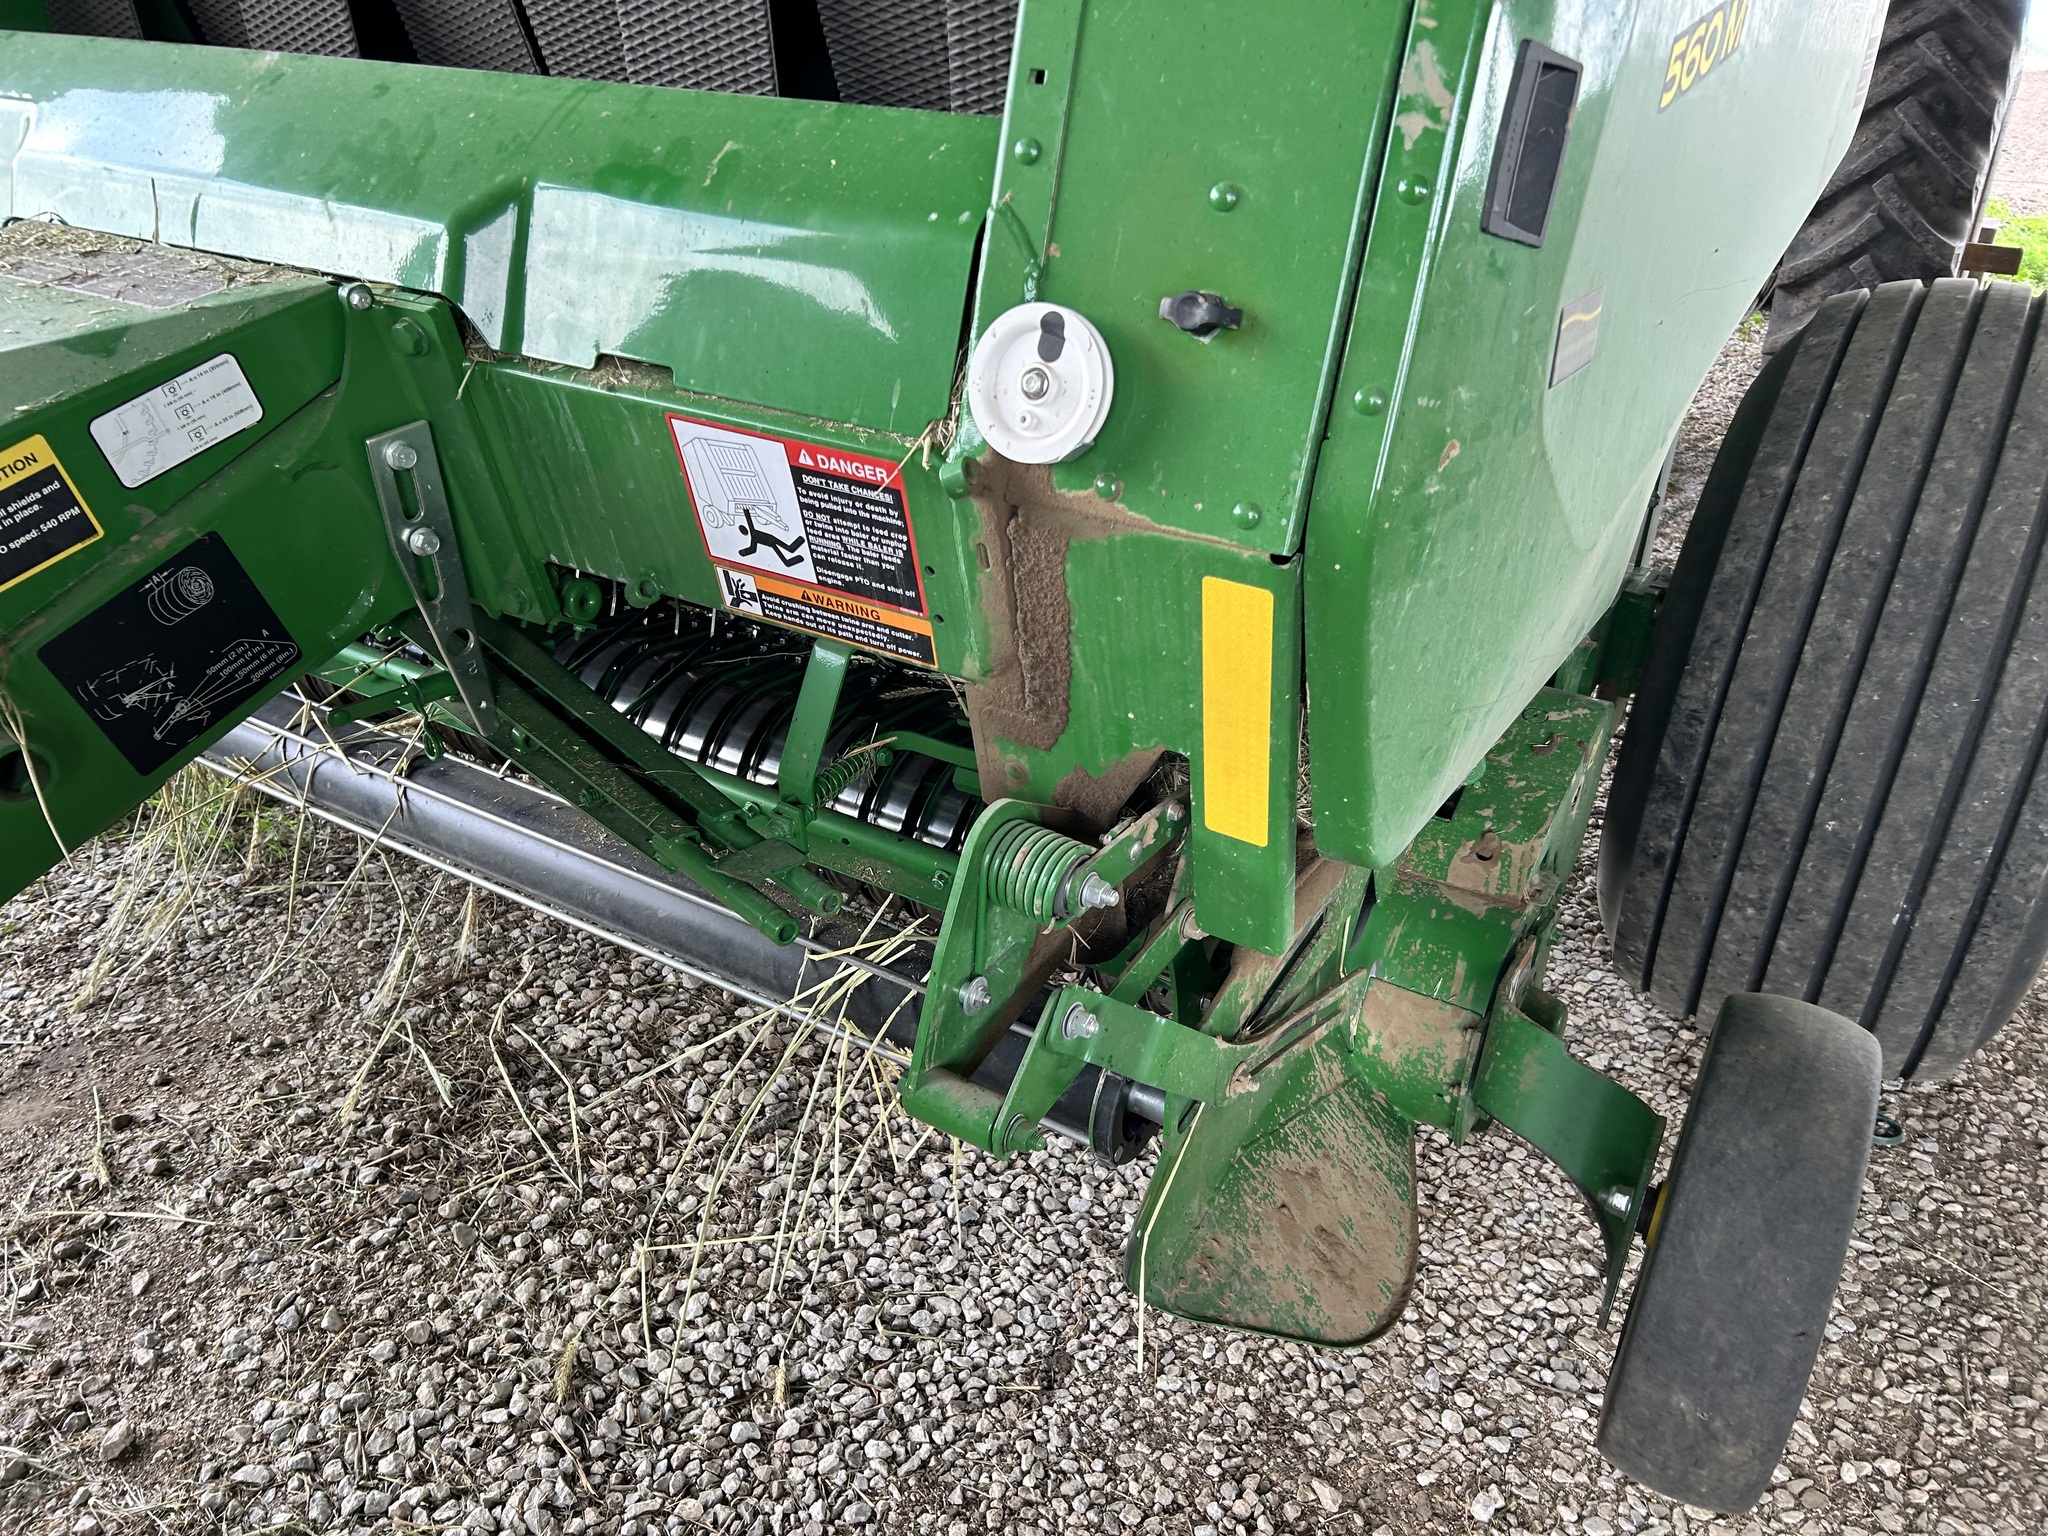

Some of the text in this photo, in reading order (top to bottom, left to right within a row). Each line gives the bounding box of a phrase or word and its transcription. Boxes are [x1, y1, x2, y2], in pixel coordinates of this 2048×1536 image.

[0, 452, 38, 480] TION
[816, 454, 888, 482] DANGER
[7, 491, 41, 512] shields
[42, 480, 60, 496] and
[798, 487, 806, 495] To
[808, 490, 829, 500] avoid
[830, 495, 853, 507] injury
[865, 503, 887, 514] death
[889, 509, 899, 518] by
[802, 474, 893, 503] DON'T TAKE CHANCES!
[2, 504, 43, 528] in place.
[799, 496, 819, 508] being
[820, 501, 842, 513] pulled
[843, 507, 857, 516] into
[858, 510, 870, 518] the
[9, 528, 41, 550] speed:
[40, 518, 58, 533] 540
[57, 506, 81, 523] RPM
[803, 510, 814, 519] DO
[816, 513, 831, 523] NOT
[833, 517, 861, 531] attempt
[872, 527, 888, 536] feed
[890, 532, 907, 542] crop
[814, 521, 833, 531] twine
[835, 526, 849, 535] into
[851, 530, 869, 540] baler
[881, 538, 907, 550] unplug
[807, 527, 904, 558] feed area WHILE BALER IS
[847, 545, 860, 554] The
[861, 549, 879, 559] baler
[881, 554, 901, 564] feeds
[810, 544, 895, 572] material faster than you
[812, 552, 826, 560] can
[827, 555, 854, 568] release
[152, 575, 161, 585] A
[816, 566, 916, 598] Disengage PTO and shut off
[818, 575, 844, 588] engine.
[761, 593, 914, 642] Avoid crushing between twine arm and cutter.
[763, 601, 889, 643] Twine arm can move unexpectedly.
[813, 594, 880, 621] WARNING
[261, 629, 269, 637] A
[765, 609, 782, 619] Keep
[783, 613, 804, 625] hands
[805, 620, 817, 629] out
[827, 626, 836, 634] its
[838, 629, 854, 640] path
[855, 634, 868, 643] and
[870, 639, 884, 648] turn
[886, 643, 896, 651] off
[898, 647, 922, 660] power.
[206, 642, 249, 675] 50mm (2 in.)
[219, 642, 265, 678] 100mm (4 in.)
[235, 659, 260, 679] 150mm
[260, 653, 268, 662] (6
[267, 644, 280, 655] in.)
[251, 661, 277, 682] 200mm
[166, 681, 175, 689] A
